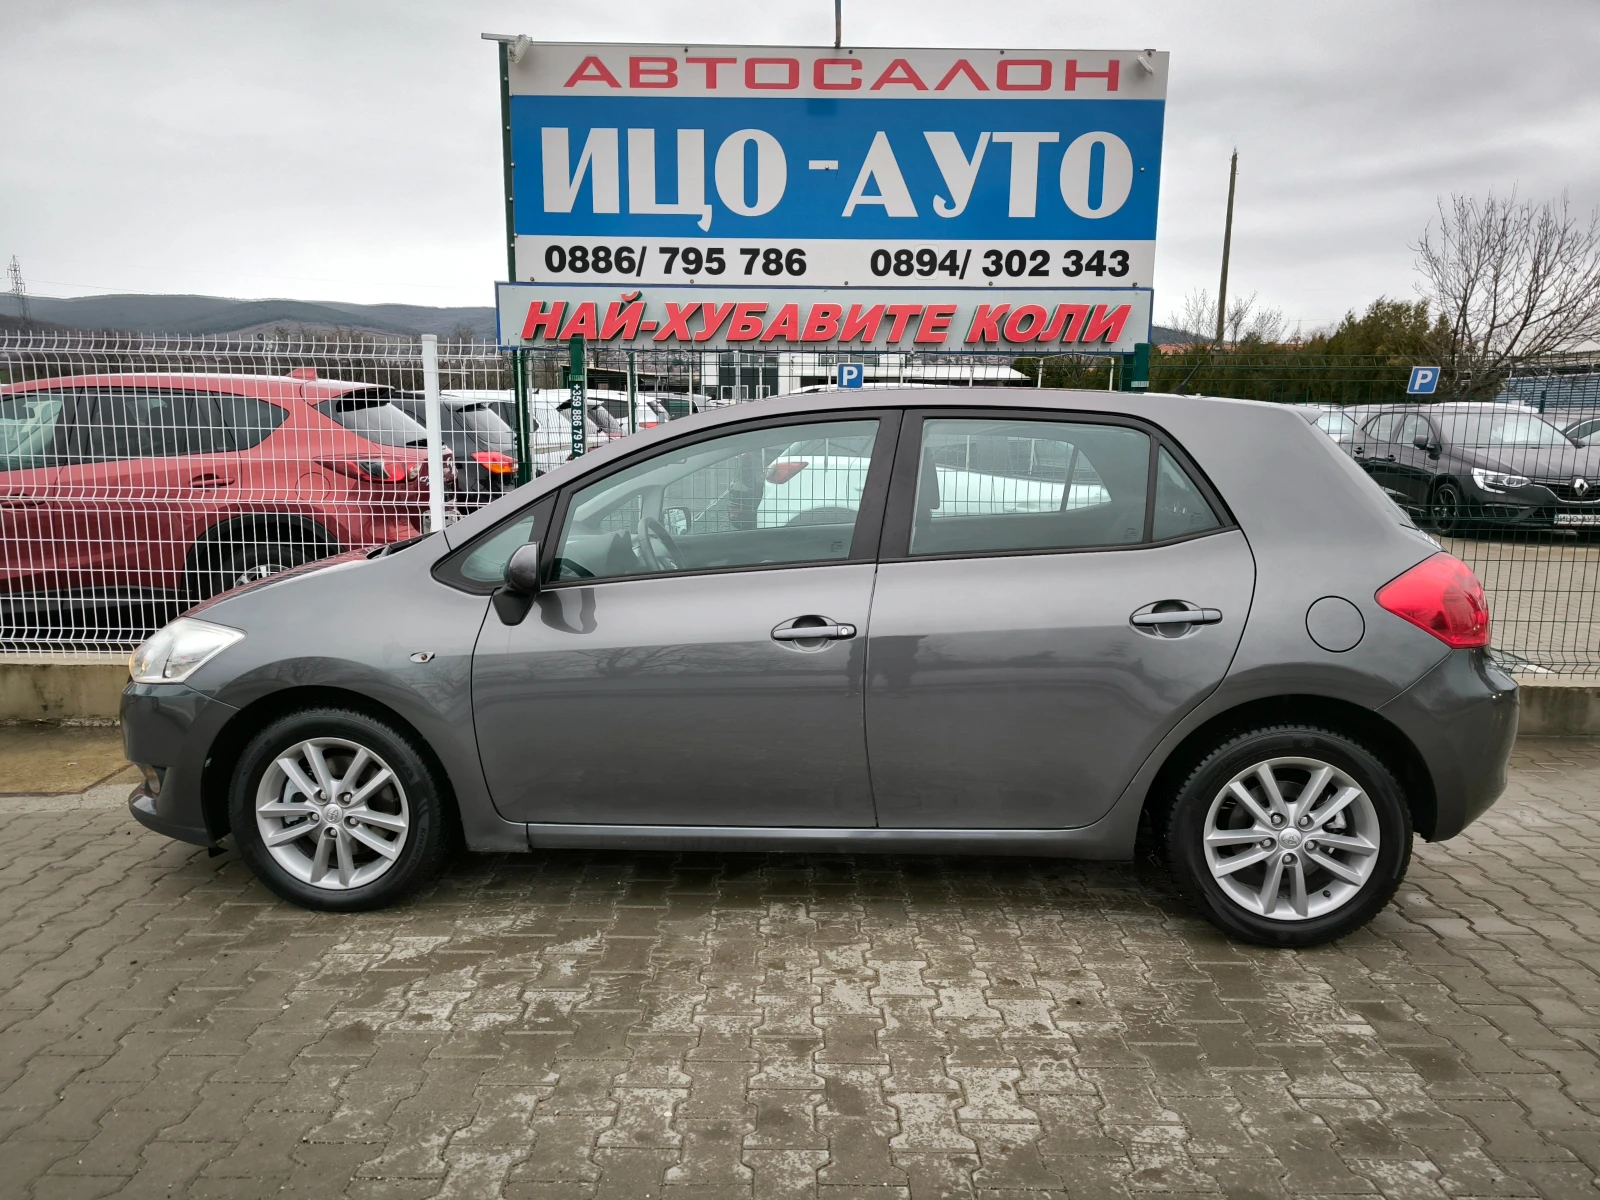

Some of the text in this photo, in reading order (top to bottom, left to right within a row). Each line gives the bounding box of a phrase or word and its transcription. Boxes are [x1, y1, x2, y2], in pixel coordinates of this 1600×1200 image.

[563, 55, 1120, 91] АВТОСАЛОН
[544, 244, 807, 277] 0886/ 795 786
[870, 248, 1131, 280] 0894/ 302 343
[519, 290, 1133, 344] НАЙ-ХУБАВИТЕ КОЛИ
[842, 366, 858, 386] P
[1414, 370, 1433, 390] P
[572, 383, 584, 454] +359 886 79 57
